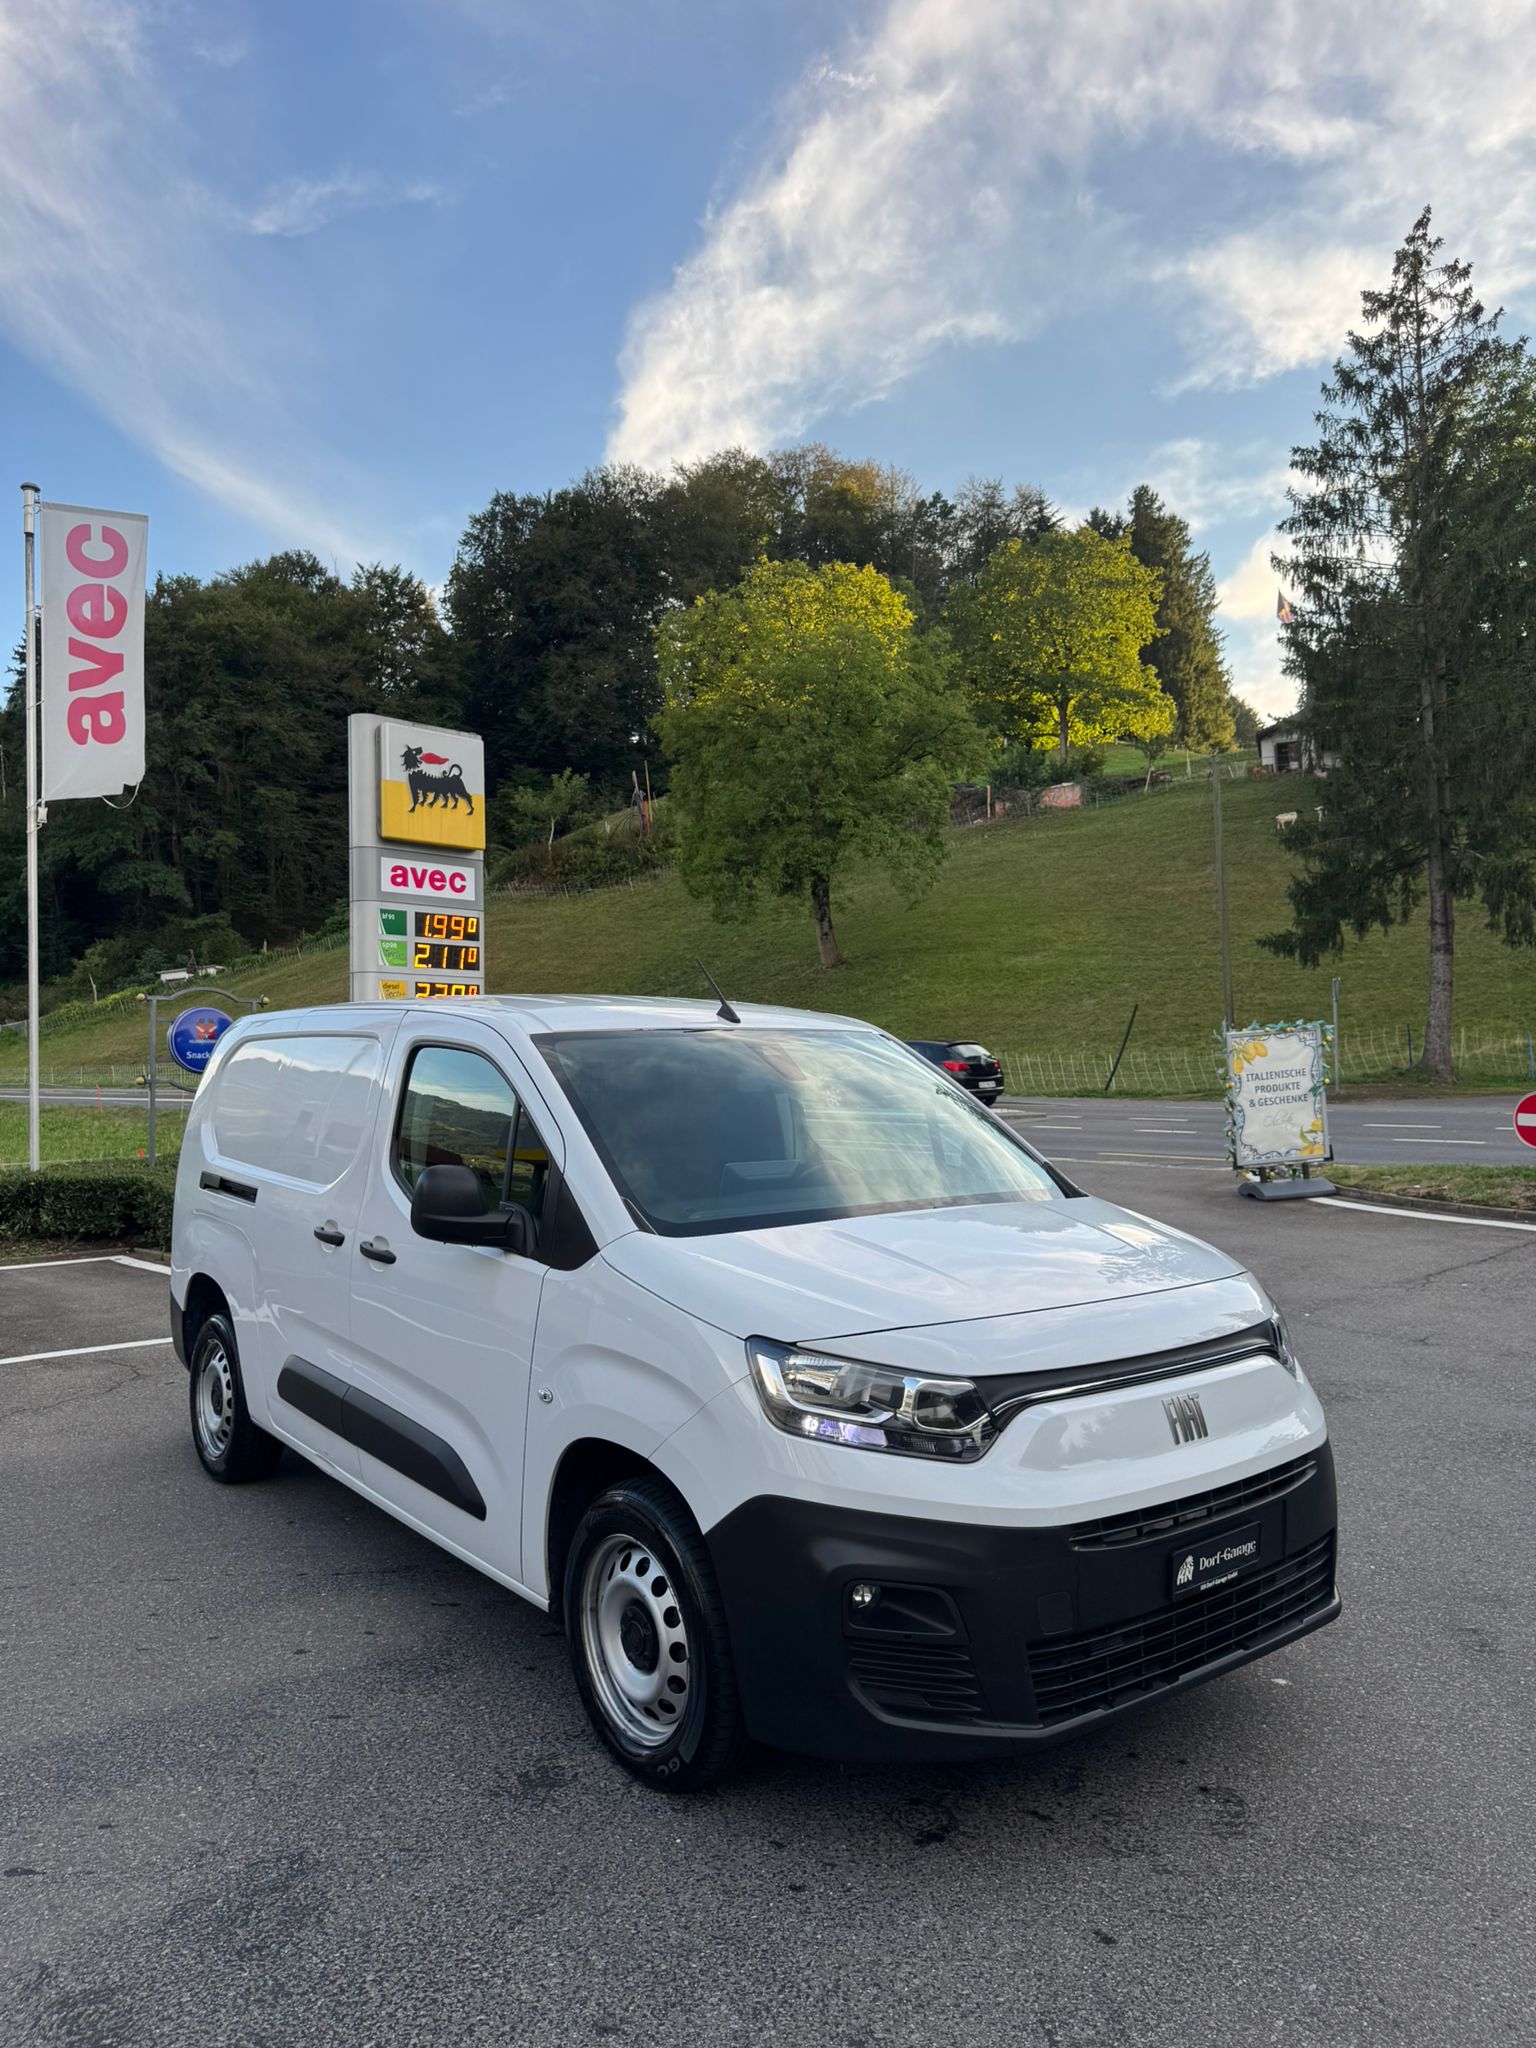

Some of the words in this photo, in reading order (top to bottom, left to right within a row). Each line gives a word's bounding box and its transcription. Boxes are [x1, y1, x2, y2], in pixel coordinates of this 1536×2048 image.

[66, 523, 129, 746] avec
[390, 864, 467, 894] avec
[382, 982, 400, 990] diesel
[186, 1050, 210, 1060] Snack
[1246, 1067, 1307, 1082] ITALIENISCHE
[1254, 1081, 1302, 1094] PRODUKTE
[1248, 1098, 1256, 1108] &
[1257, 1093, 1309, 1107] GESCHENKE
[1161, 1392, 1209, 1446] FIAT
[1199, 1540, 1257, 1571] Dorf-Garage
